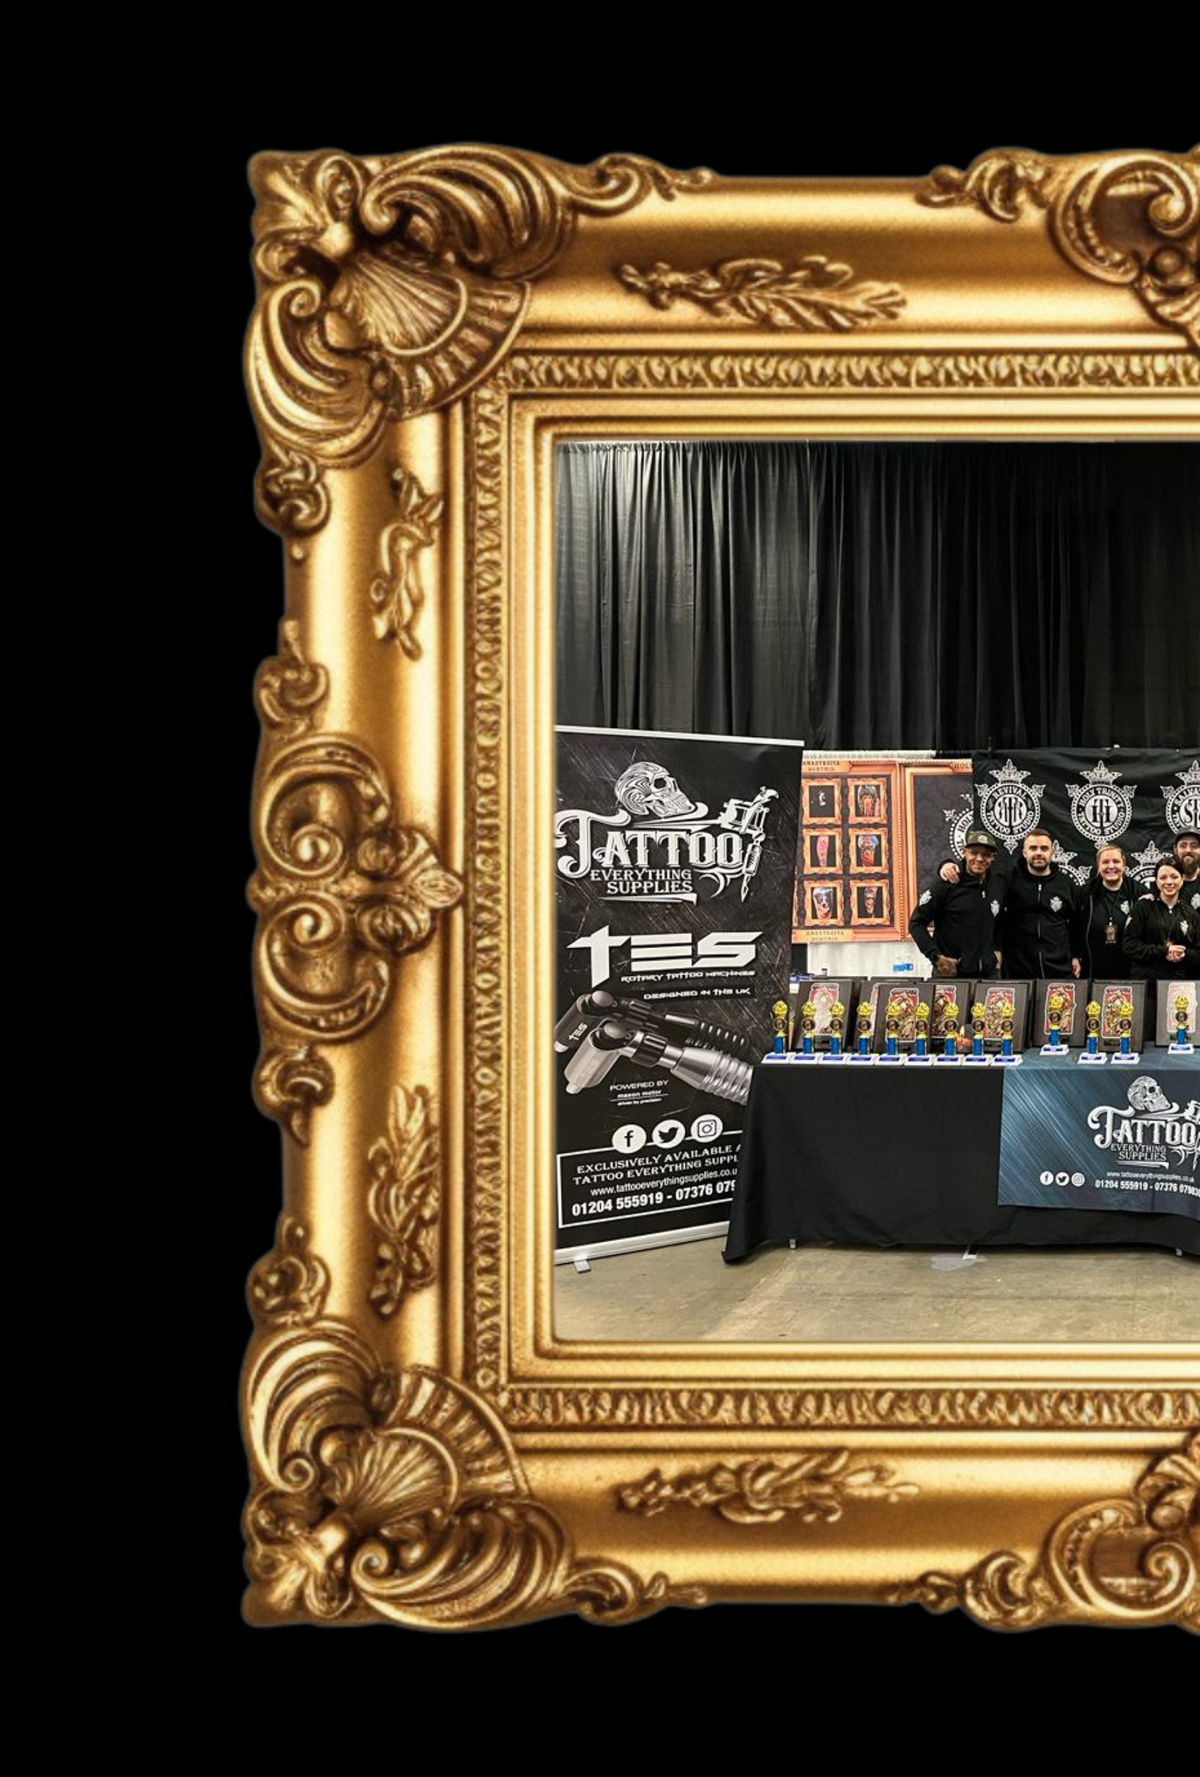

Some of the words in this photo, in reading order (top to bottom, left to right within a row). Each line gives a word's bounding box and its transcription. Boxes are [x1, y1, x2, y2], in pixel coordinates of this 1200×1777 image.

[992, 786, 1028, 800] REVIVAL
[1078, 788, 1095, 807] HOLY
[987, 810, 1011, 834] TATTOO
[1012, 810, 1035, 834] STUDIO
[1078, 811, 1102, 835] TATTOO
[1103, 811, 1125, 835] STUDIO
[554, 808, 743, 878] TATTOO
[590, 868, 692, 882] EVERYTHING
[607, 880, 693, 895] SUPPLIES
[621, 974, 663, 983] ROTARY
[666, 971, 703, 980] TATTOO
[705, 970, 755, 978] MACHINES
[643, 990, 698, 1000] DESIGNED
[712, 988, 733, 996] THE
[735, 987, 751, 995] UK
[610, 1081, 655, 1091] POWERED
[656, 1079, 669, 1087] BY
[1087, 1105, 1197, 1149] TATTOO
[1110, 1143, 1167, 1153] EVERYTHING
[577, 1153, 662, 1174] EXCLUSIVELY
[664, 1144, 733, 1163] AVAILABLE
[1118, 1151, 1167, 1161] SUPPLIES
[572, 1171, 624, 1186] TATTOO
[627, 1160, 702, 1178] EVERYTHING
[1094, 1179, 1119, 1189] 01204
[1120, 1180, 1148, 1191] 555919
[1154, 1182, 1178, 1192] 07376
[572, 1199, 613, 1216] 01204
[616, 1191, 664, 1210] 555919
[675, 1183, 713, 1201] 07376
